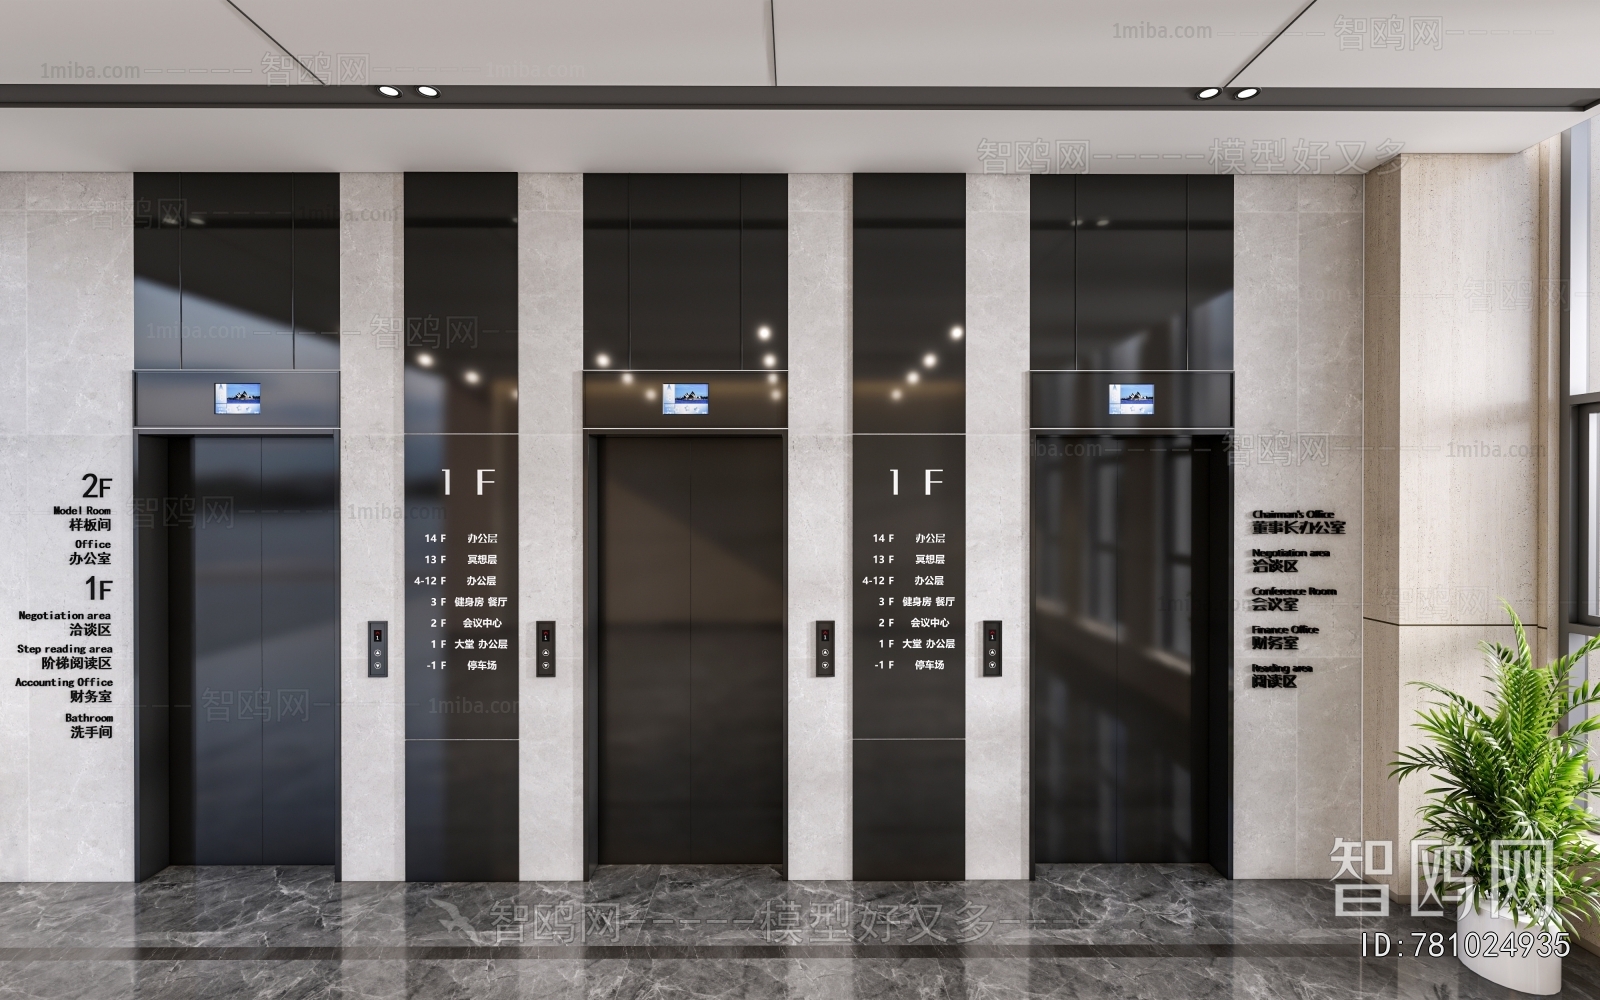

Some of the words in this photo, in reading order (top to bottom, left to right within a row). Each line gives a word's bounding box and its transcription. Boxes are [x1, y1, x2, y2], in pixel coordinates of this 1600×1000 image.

[82, 474, 112, 497] 2F
[442, 469, 450, 495] 1
[477, 469, 495, 495] F
[890, 469, 898, 495] 1
[925, 470, 943, 495] F
[54, 506, 81, 515] Model
[87, 506, 111, 514] Room
[69, 518, 111, 531] 样板间
[1253, 521, 1346, 534] 董事长办公室
[75, 540, 111, 548] Office
[424, 533, 438, 543] 14
[440, 533, 447, 543] F
[467, 533, 498, 544] 办公层
[873, 533, 886, 543] 14
[888, 533, 895, 543] F
[915, 532, 946, 544] 办公层
[69, 552, 111, 565] 办公室
[424, 554, 437, 564] 13
[440, 555, 447, 564] F
[467, 554, 498, 565] 冥想层
[872, 554, 885, 564] 13
[888, 554, 895, 564] F
[915, 553, 946, 565] 冥想层
[1252, 549, 1307, 559] Negotiation
[1310, 550, 1331, 558] area
[1253, 559, 1298, 572] 洽谈区
[413, 576, 437, 586] 4-12
[440, 576, 447, 586] F
[466, 575, 497, 586] 办公层
[862, 576, 885, 585] 4-12
[888, 576, 895, 585] F
[914, 575, 945, 586] 办公层
[86, 576, 113, 600] 1F
[1252, 587, 1307, 595] Conference
[1309, 587, 1337, 595] Room
[430, 597, 437, 607] 3
[440, 597, 447, 607] F
[454, 596, 485, 608] 健身房
[487, 596, 508, 608] 餐厅
[878, 597, 885, 606] 3
[888, 597, 895, 606] F
[902, 596, 933, 607] 健身房
[935, 596, 956, 607] 餐厅
[1252, 597, 1298, 611] 会议室
[19, 611, 84, 621] Negotiation
[430, 618, 437, 628] 2
[440, 618, 447, 628] F
[462, 617, 503, 629] 会议中心
[878, 618, 885, 627] 2
[888, 618, 895, 627] F
[910, 617, 950, 628] 会议中心
[70, 623, 111, 636] 洽谈区
[1252, 626, 1289, 634] Finance
[1291, 625, 1319, 634] Office
[430, 639, 436, 649] 1
[440, 639, 447, 649] F
[454, 638, 475, 650] 大堂
[478, 638, 509, 650] 办公层
[878, 639, 884, 648] 1
[888, 639, 895, 648] F
[902, 638, 923, 649] 大堂
[925, 638, 956, 649] 办公层
[1252, 636, 1299, 650] 财务室
[18, 645, 41, 654] Step
[45, 645, 86, 654] reading
[89, 646, 113, 654] area
[42, 656, 112, 669] 阶梯阅读区
[426, 660, 436, 670] -1
[440, 660, 447, 670] F
[467, 659, 497, 671] 停车场
[874, 660, 884, 670] -1
[888, 660, 895, 670] F
[914, 659, 945, 671] 停车场
[15, 678, 74, 688] Accounting
[78, 678, 113, 686] Office
[1252, 674, 1297, 688] 阅读区
[71, 690, 112, 703] 财务室
[66, 714, 113, 722] Bathroom
[71, 725, 112, 738] 洗手间
